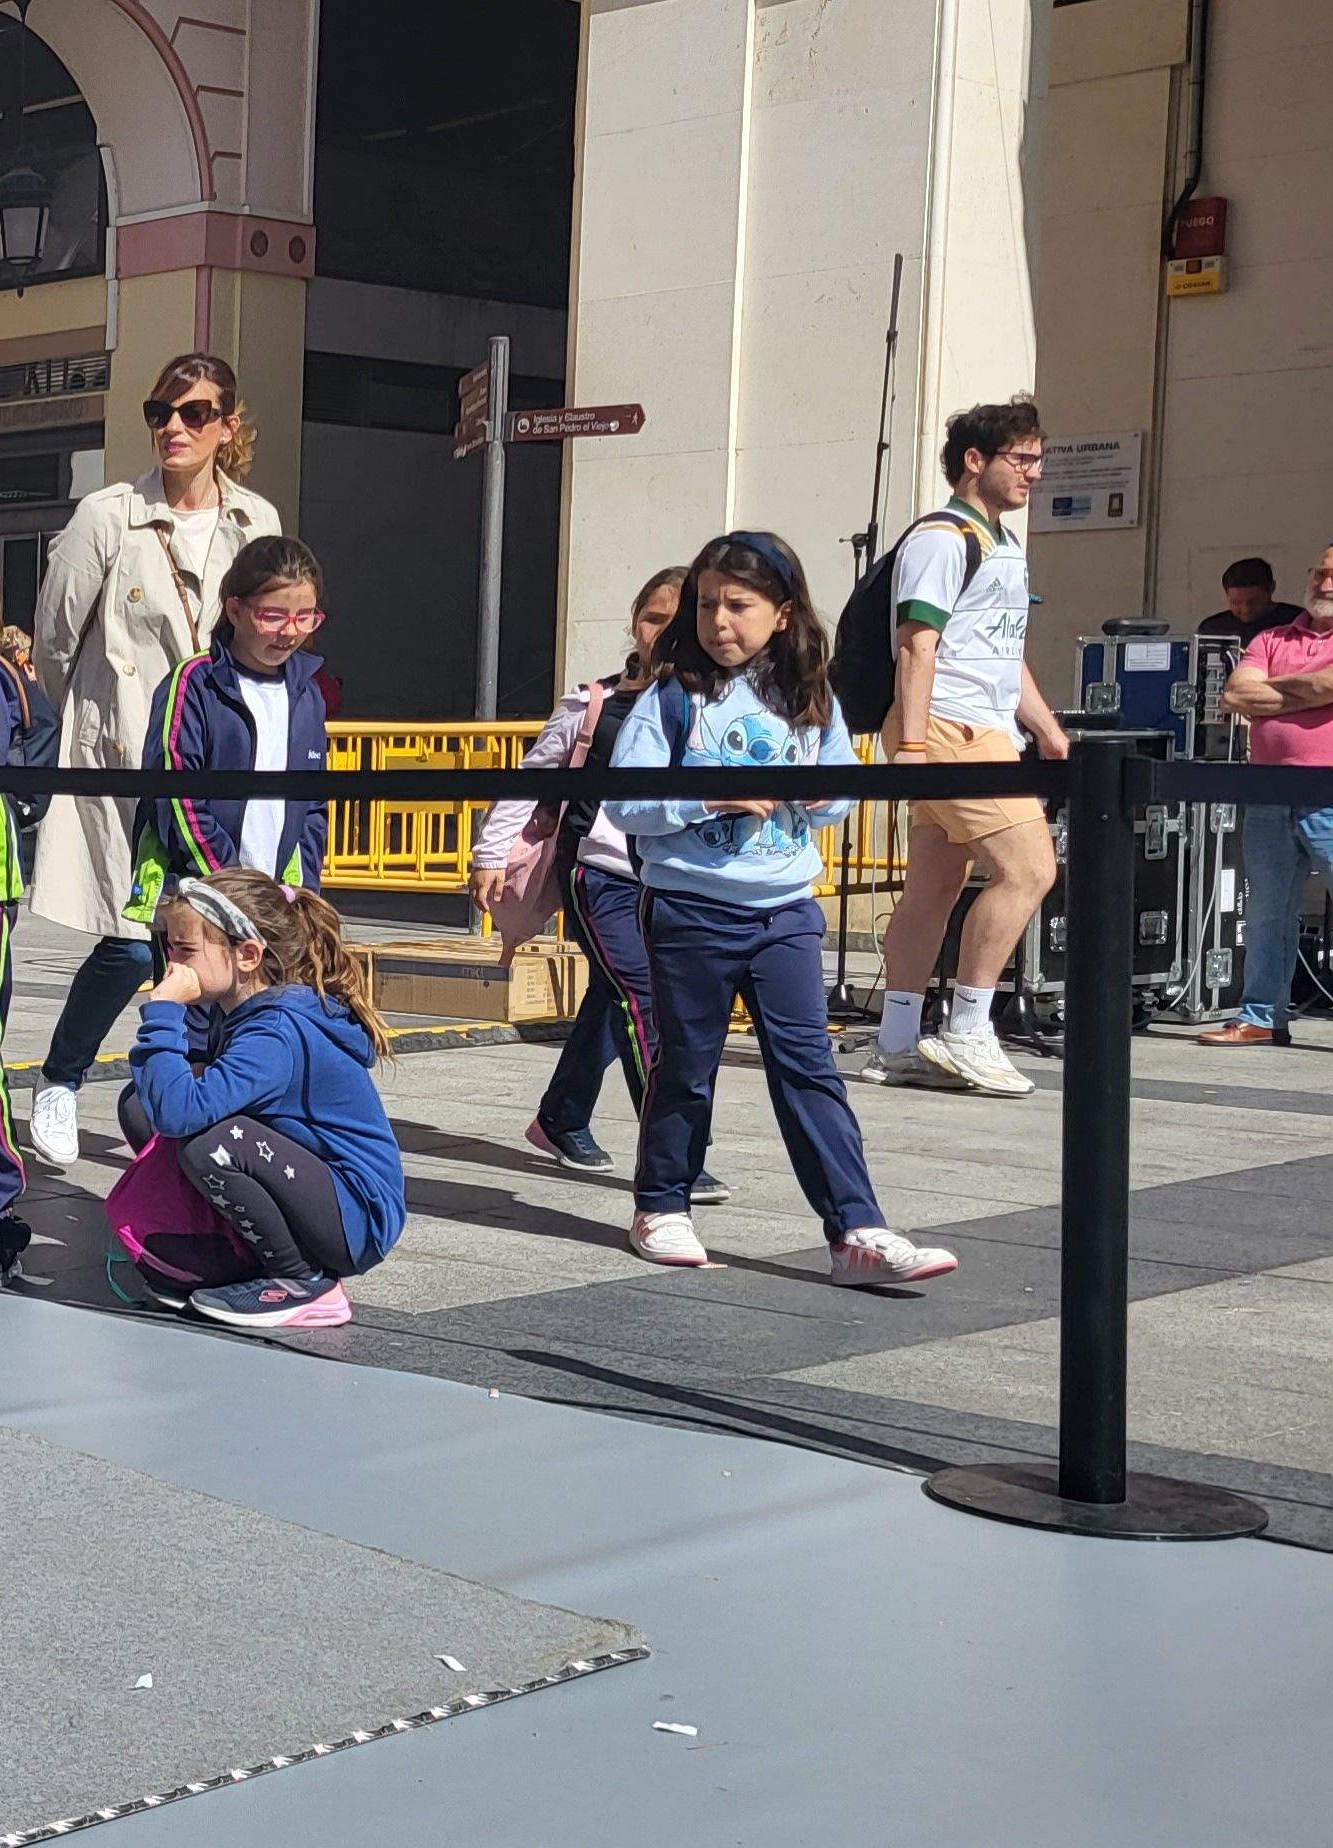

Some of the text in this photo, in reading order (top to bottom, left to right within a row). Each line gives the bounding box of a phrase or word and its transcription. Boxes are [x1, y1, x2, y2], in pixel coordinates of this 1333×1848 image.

[533, 414, 557, 425] Iglesia
[564, 412, 595, 422] Claustro
[533, 424, 543, 435] de
[544, 424, 559, 434] San
[559, 422, 581, 433] Pedro
[582, 422, 590, 432] el
[1076, 441, 1120, 453] URBANA
